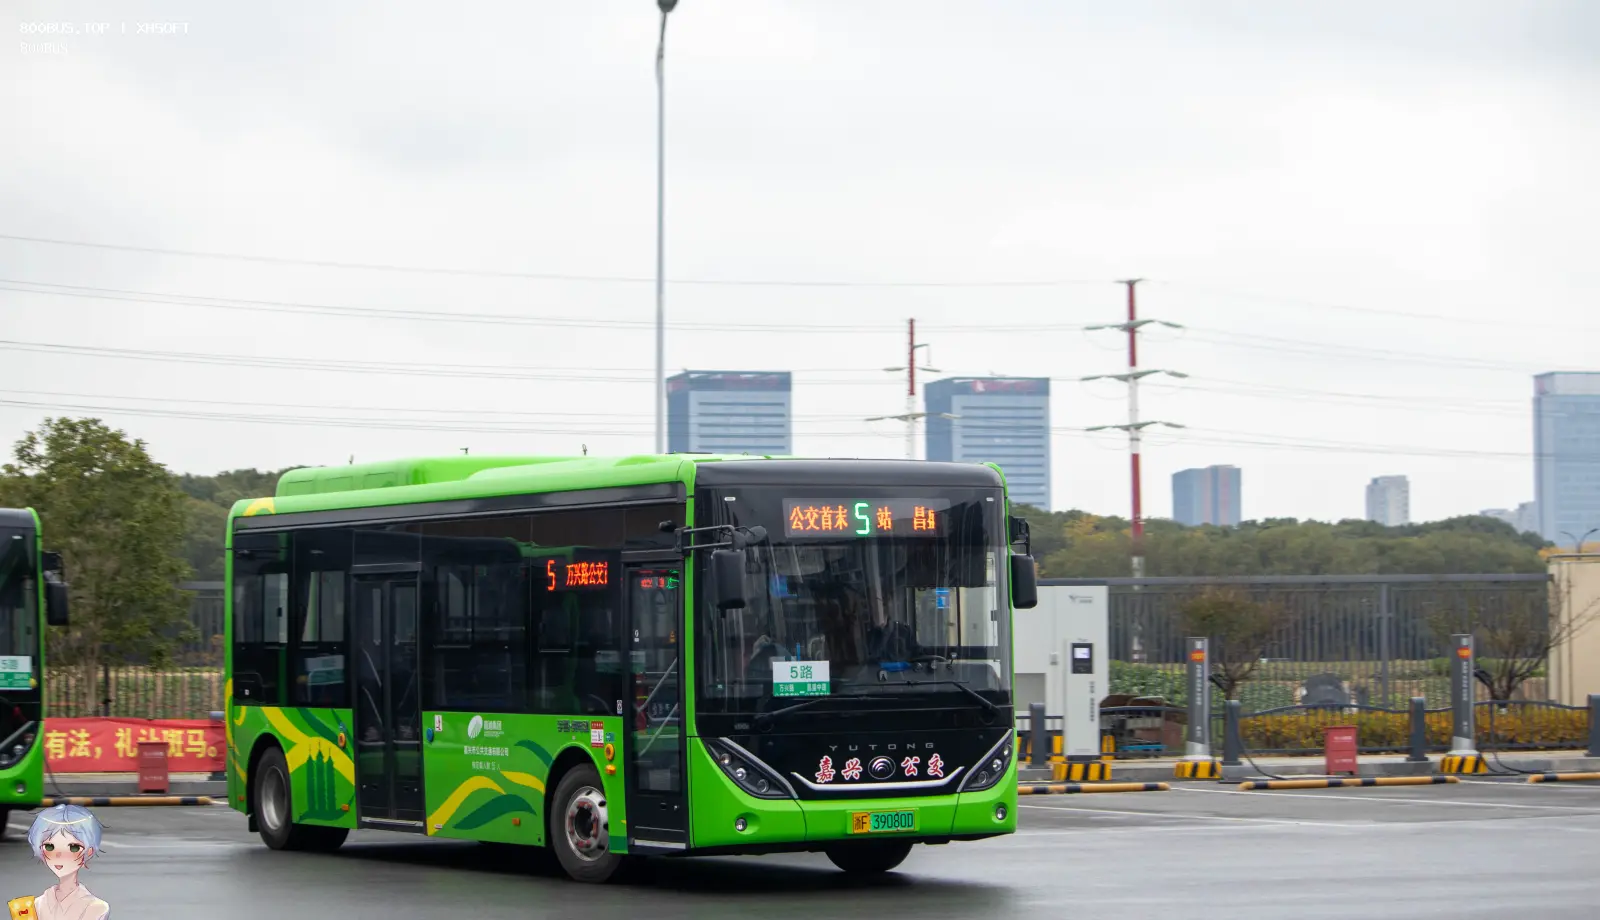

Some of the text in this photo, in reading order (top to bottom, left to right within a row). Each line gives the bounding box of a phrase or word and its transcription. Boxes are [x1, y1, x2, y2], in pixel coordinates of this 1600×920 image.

[790, 505, 848, 530] 公交首末
[854, 502, 870, 535] 5
[876, 506, 893, 530] 站
[547, 560, 556, 591] 5
[565, 561, 608, 586] 万兴路公交
[790, 665, 813, 679] 5路
[829, 742, 934, 751] YUTONG
[815, 753, 944, 783] 嘉兴 公交
